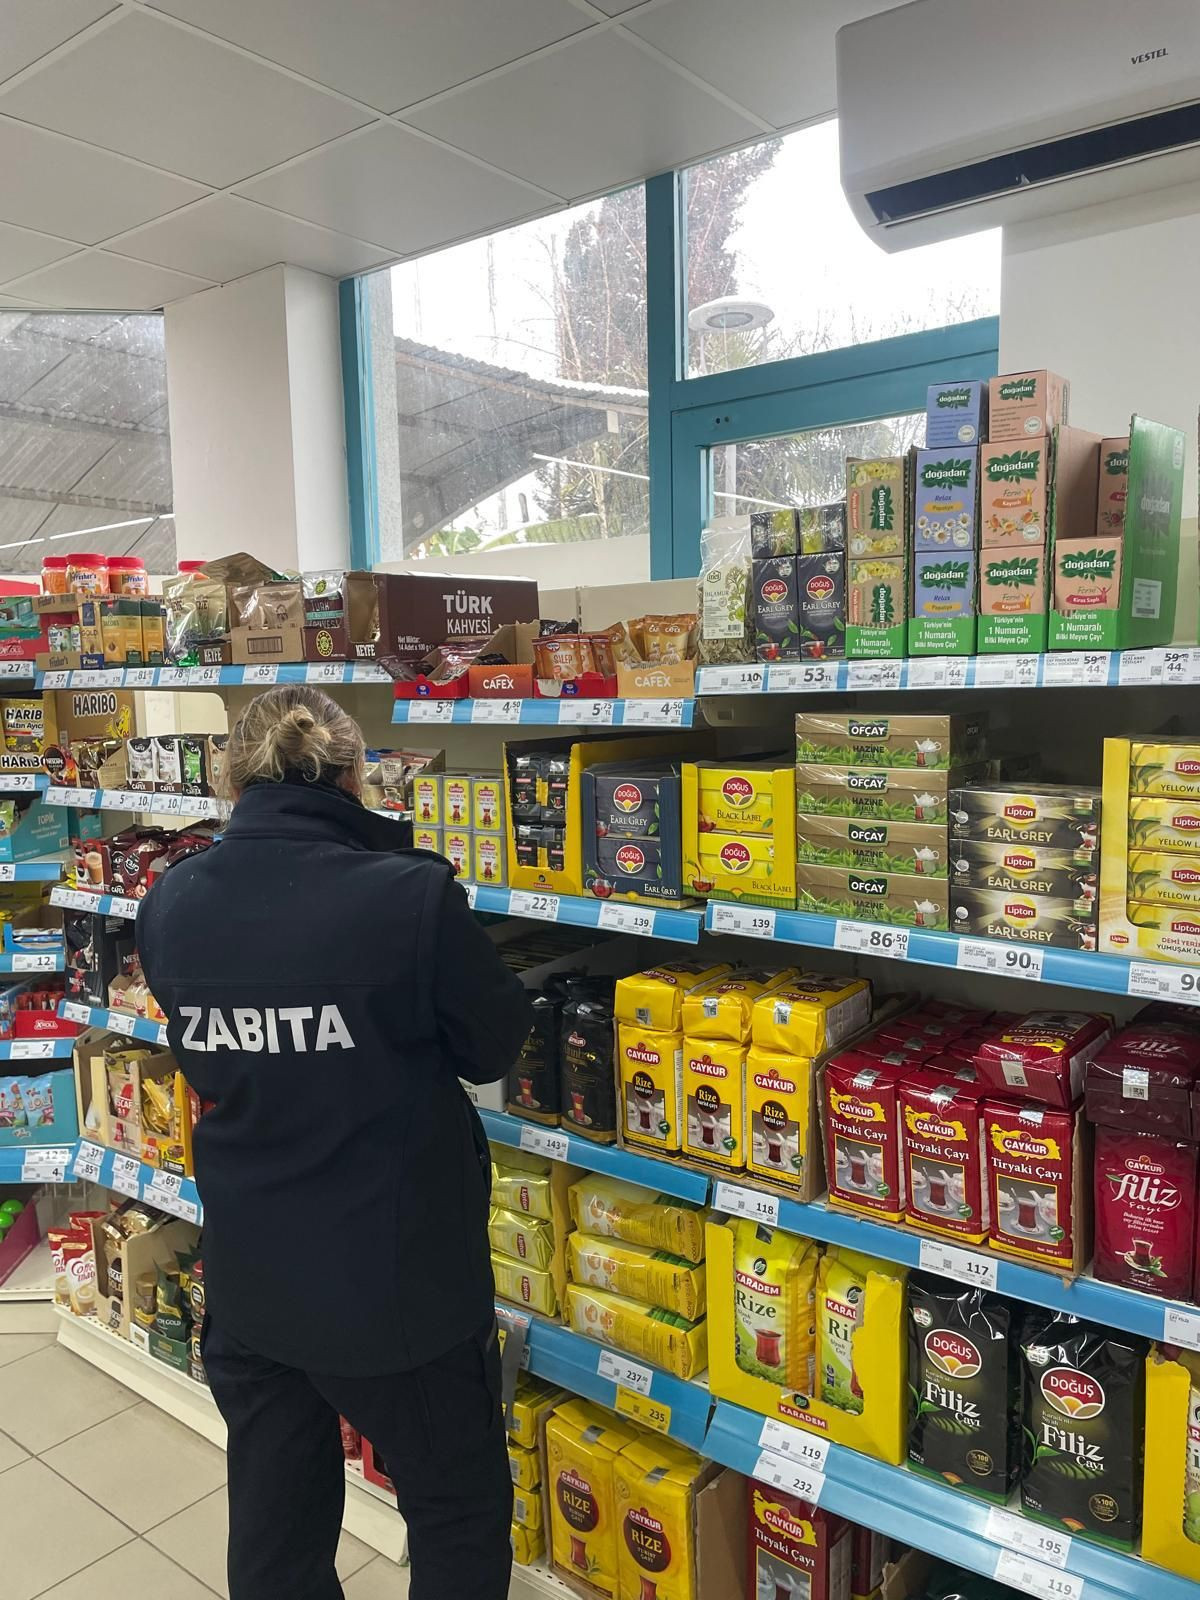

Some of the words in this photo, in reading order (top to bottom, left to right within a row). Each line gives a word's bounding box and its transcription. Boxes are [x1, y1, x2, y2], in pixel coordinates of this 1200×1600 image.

[1131, 48, 1168, 64] VESTEL
[926, 468, 966, 478] doğadan
[991, 461, 1034, 473] doğadan
[1065, 559, 1109, 571] doğadan
[924, 571, 964, 581] doğadan
[990, 568, 1032, 578] doğadan
[442, 590, 494, 614] TÜRK
[758, 604, 773, 614] EARL
[775, 603, 794, 613] GREY
[803, 601, 818, 611] EARL
[820, 600, 840, 610] GREY
[447, 616, 491, 634] KAHVESİ
[995, 626, 1029, 635] Numaralı
[1066, 623, 1102, 632] Numaralı
[924, 631, 956, 640] Numaralı
[861, 638, 891, 648] Numaralı
[204, 648, 222, 663] KEYFE
[356, 643, 376, 657] KEYFE
[554, 654, 572, 664] SALEP
[949, 669, 962, 678] 44
[1087, 664, 1100, 674] 44
[1168, 662, 1182, 672] 44
[804, 667, 824, 682] 53
[483, 678, 514, 690] CAFEX
[635, 676, 672, 688] CAFEX
[73, 692, 116, 716] HARIBO
[660, 702, 682, 716] 4,50
[851, 726, 886, 736] OFÇAY
[853, 744, 884, 753] HAZİNE
[160, 782, 176, 792] CAFEX
[727, 783, 749, 794] DOĞUŞ
[850, 778, 884, 790] OFÇAY
[1160, 784, 1194, 792] YELLOW
[618, 788, 638, 800] DOĞUŞ
[852, 797, 884, 806] HAZİNE
[717, 808, 740, 820] BLACK
[742, 810, 762, 822] LABEL
[1007, 807, 1034, 818] Lipton
[610, 814, 628, 826] EARL
[629, 816, 648, 827] GREY
[850, 830, 884, 842] OFÇAY
[987, 827, 1018, 842] EARL
[1020, 829, 1052, 843] GREY
[1158, 838, 1192, 848] YELLOW
[621, 850, 640, 860] DOĞUŞ
[724, 848, 746, 860] DOĞUŞ
[853, 848, 884, 858] HAZİNE
[1007, 856, 1034, 868] Lipton
[2, 865, 8, 874] 5
[1174, 872, 1200, 881] Lipton
[644, 883, 660, 894] EARL
[662, 885, 677, 896] GREY
[752, 880, 772, 890] BLACK
[772, 882, 792, 894] LABEL
[851, 882, 885, 894] OFÇAY
[987, 876, 1018, 890] EARL
[1020, 878, 1052, 893] GREY
[1158, 890, 1191, 900] YELLOW
[126, 902, 135, 912] 10
[532, 896, 558, 912] 22,50
[854, 900, 884, 910] HAZİNE
[1007, 906, 1034, 918] Lipton
[634, 918, 649, 928] 139
[752, 918, 770, 928] 139
[1174, 923, 1200, 933] Lipton
[870, 930, 908, 948] 86,50
[988, 924, 1018, 940] EARL
[1020, 928, 1054, 942] GREY
[1162, 937, 1180, 945] DEMİ
[1156, 943, 1192, 954] YUMUŞAK
[36, 956, 50, 966] 12
[1006, 950, 1032, 969] 90
[178, 1004, 356, 1054] ZABITA
[42, 1044, 49, 1052] 7
[635, 1076, 652, 1088] Rize
[698, 1090, 717, 1103] Rize
[764, 1105, 784, 1119] Rize
[839, 1102, 874, 1118] ÇAYKUR
[830, 1117, 862, 1140] Tiryaki
[864, 1128, 888, 1141] Çayı
[916, 1120, 954, 1137] ÇAYKUR
[906, 1136, 942, 1158] Tiryaki
[944, 1147, 970, 1161] Çayı
[1005, 1138, 1046, 1154] ÇAYKUR
[52, 1168, 58, 1176] 4
[992, 1158, 1034, 1178] Tiryaki
[1036, 1166, 1063, 1181] Çayı
[1112, 1174, 1178, 1206] filiz
[522, 1187, 530, 1210] Lipton
[756, 1202, 774, 1215] 118
[1129, 1201, 1160, 1215] çayı
[966, 1261, 989, 1276] 117
[736, 1273, 780, 1295] KARADEM
[736, 1289, 776, 1318] Rize
[933, 1336, 972, 1360] DOĞUŞ
[1050, 1376, 1094, 1398] DOĞUŞ
[924, 1380, 981, 1418] Filiz
[650, 1408, 665, 1422] 235
[780, 1405, 826, 1428] KARADEM
[954, 1412, 980, 1428] Çayı
[1042, 1422, 1105, 1461] Filiz
[802, 1445, 821, 1460] 119
[1076, 1456, 1105, 1472] Çayı
[793, 1478, 812, 1494] 232
[563, 1490, 591, 1514] RİZE
[764, 1511, 804, 1537] ÇAYKUR
[631, 1528, 663, 1554] RİZE
[754, 1526, 789, 1554] Tiryaki
[792, 1550, 815, 1567] Çayı
[1038, 1537, 1062, 1554] 195
[1048, 1578, 1072, 1596] 119
